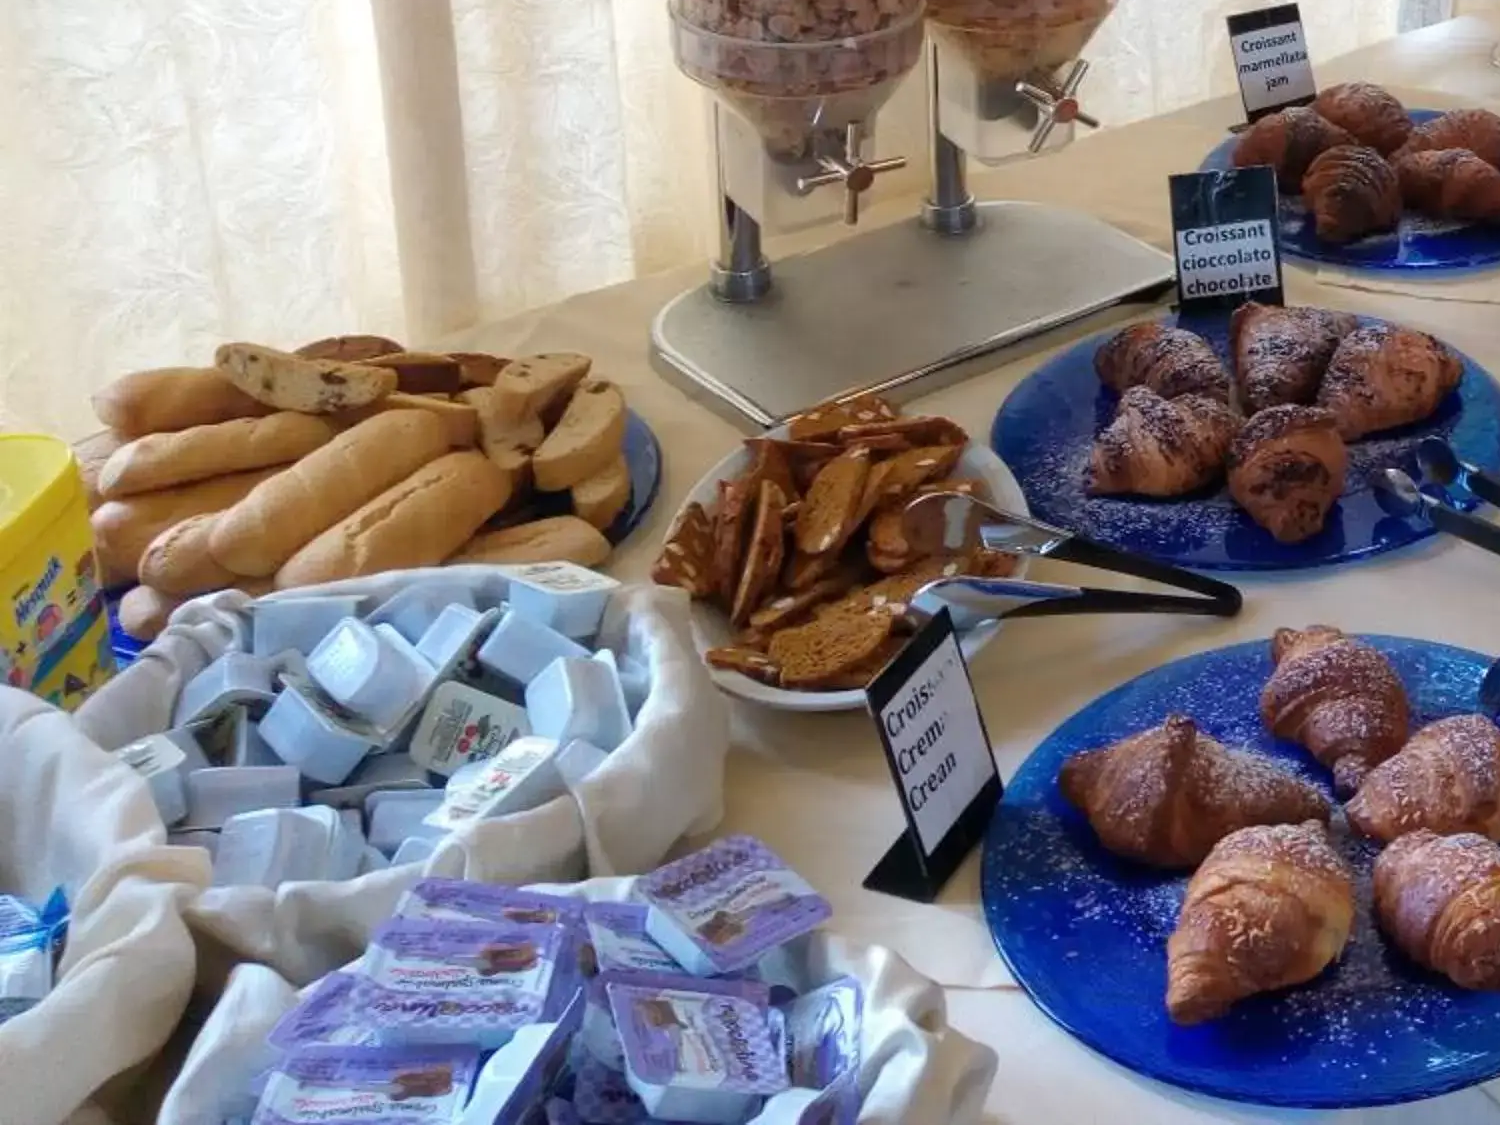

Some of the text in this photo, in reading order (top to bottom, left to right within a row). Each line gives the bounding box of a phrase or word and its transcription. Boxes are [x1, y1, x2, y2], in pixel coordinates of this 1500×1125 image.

[1241, 31, 1297, 53] Croissant
[1240, 50, 1307, 73] marmellata
[1264, 75, 1289, 92] jam
[1184, 223, 1265, 245] Croissant
[1182, 248, 1271, 271] cioccolato
[1186, 273, 1272, 295] chocolate
[898, 711, 947, 775] Crem
